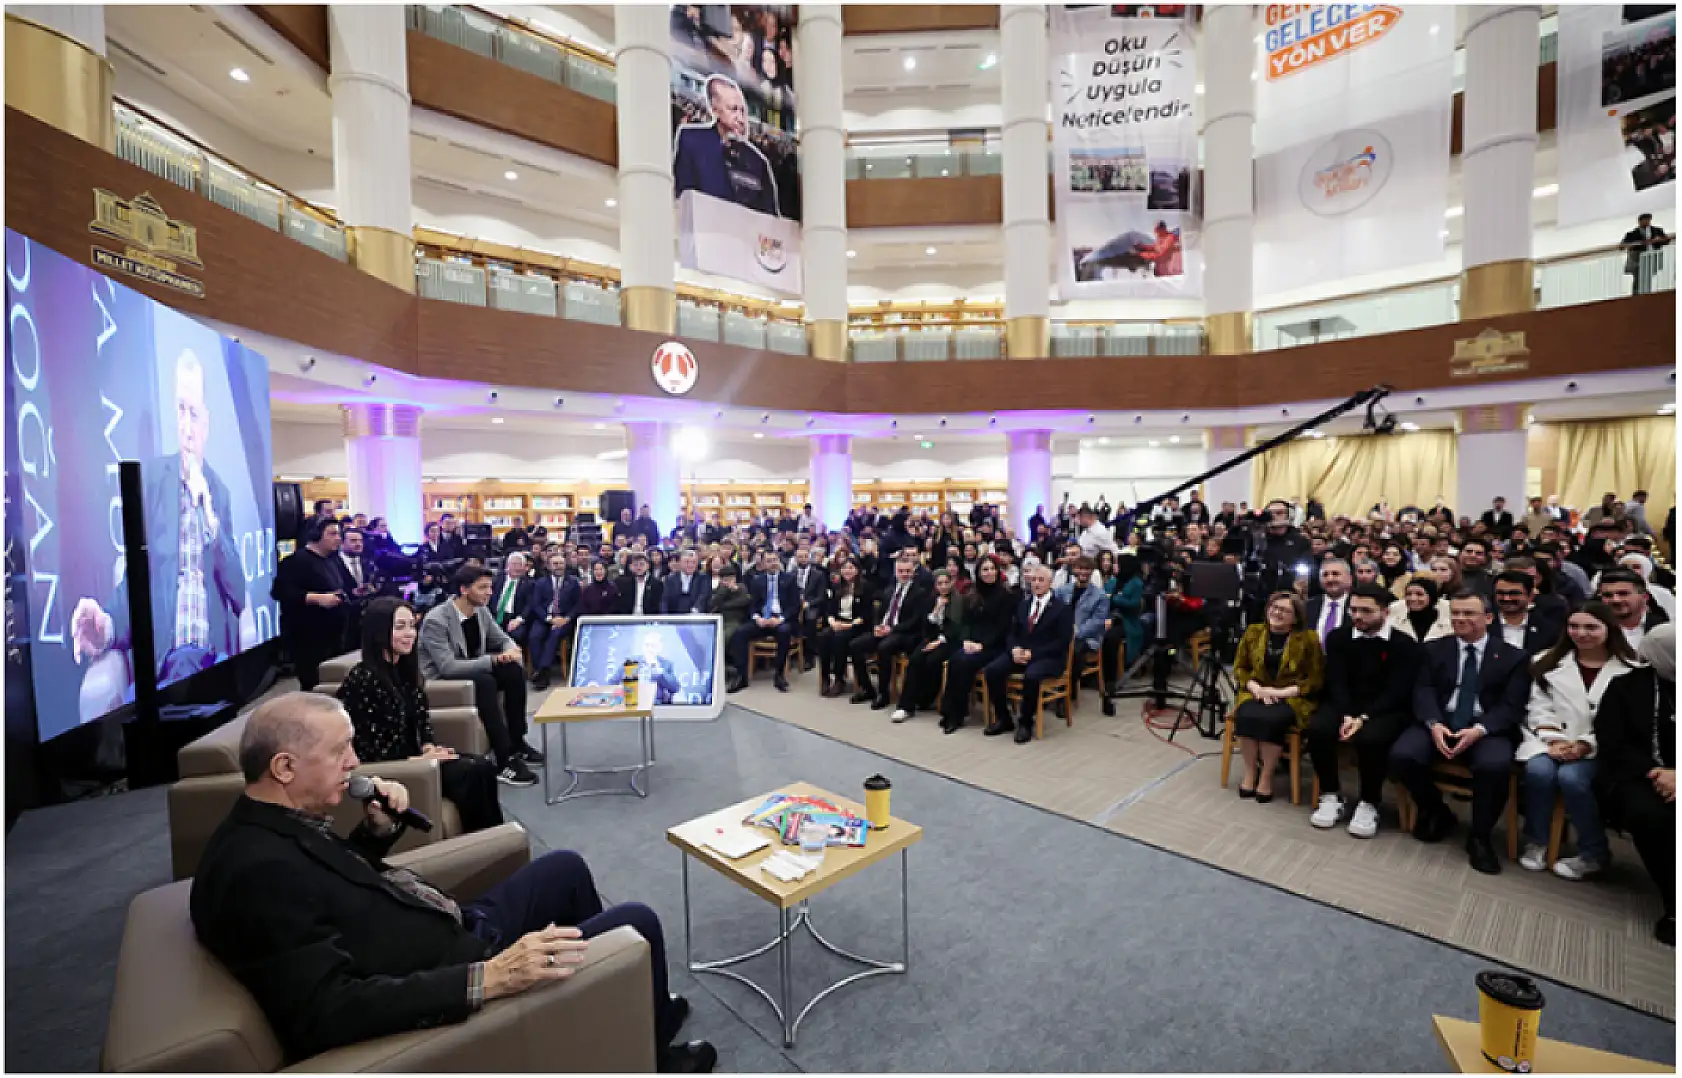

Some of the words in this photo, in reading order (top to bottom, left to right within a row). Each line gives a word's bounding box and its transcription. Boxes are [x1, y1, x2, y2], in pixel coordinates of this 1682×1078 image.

[1330, 15, 1386, 50] VER
[1104, 36, 1148, 55] Oku
[1092, 55, 1161, 77] Düşün
[1087, 77, 1162, 103] Uygula
